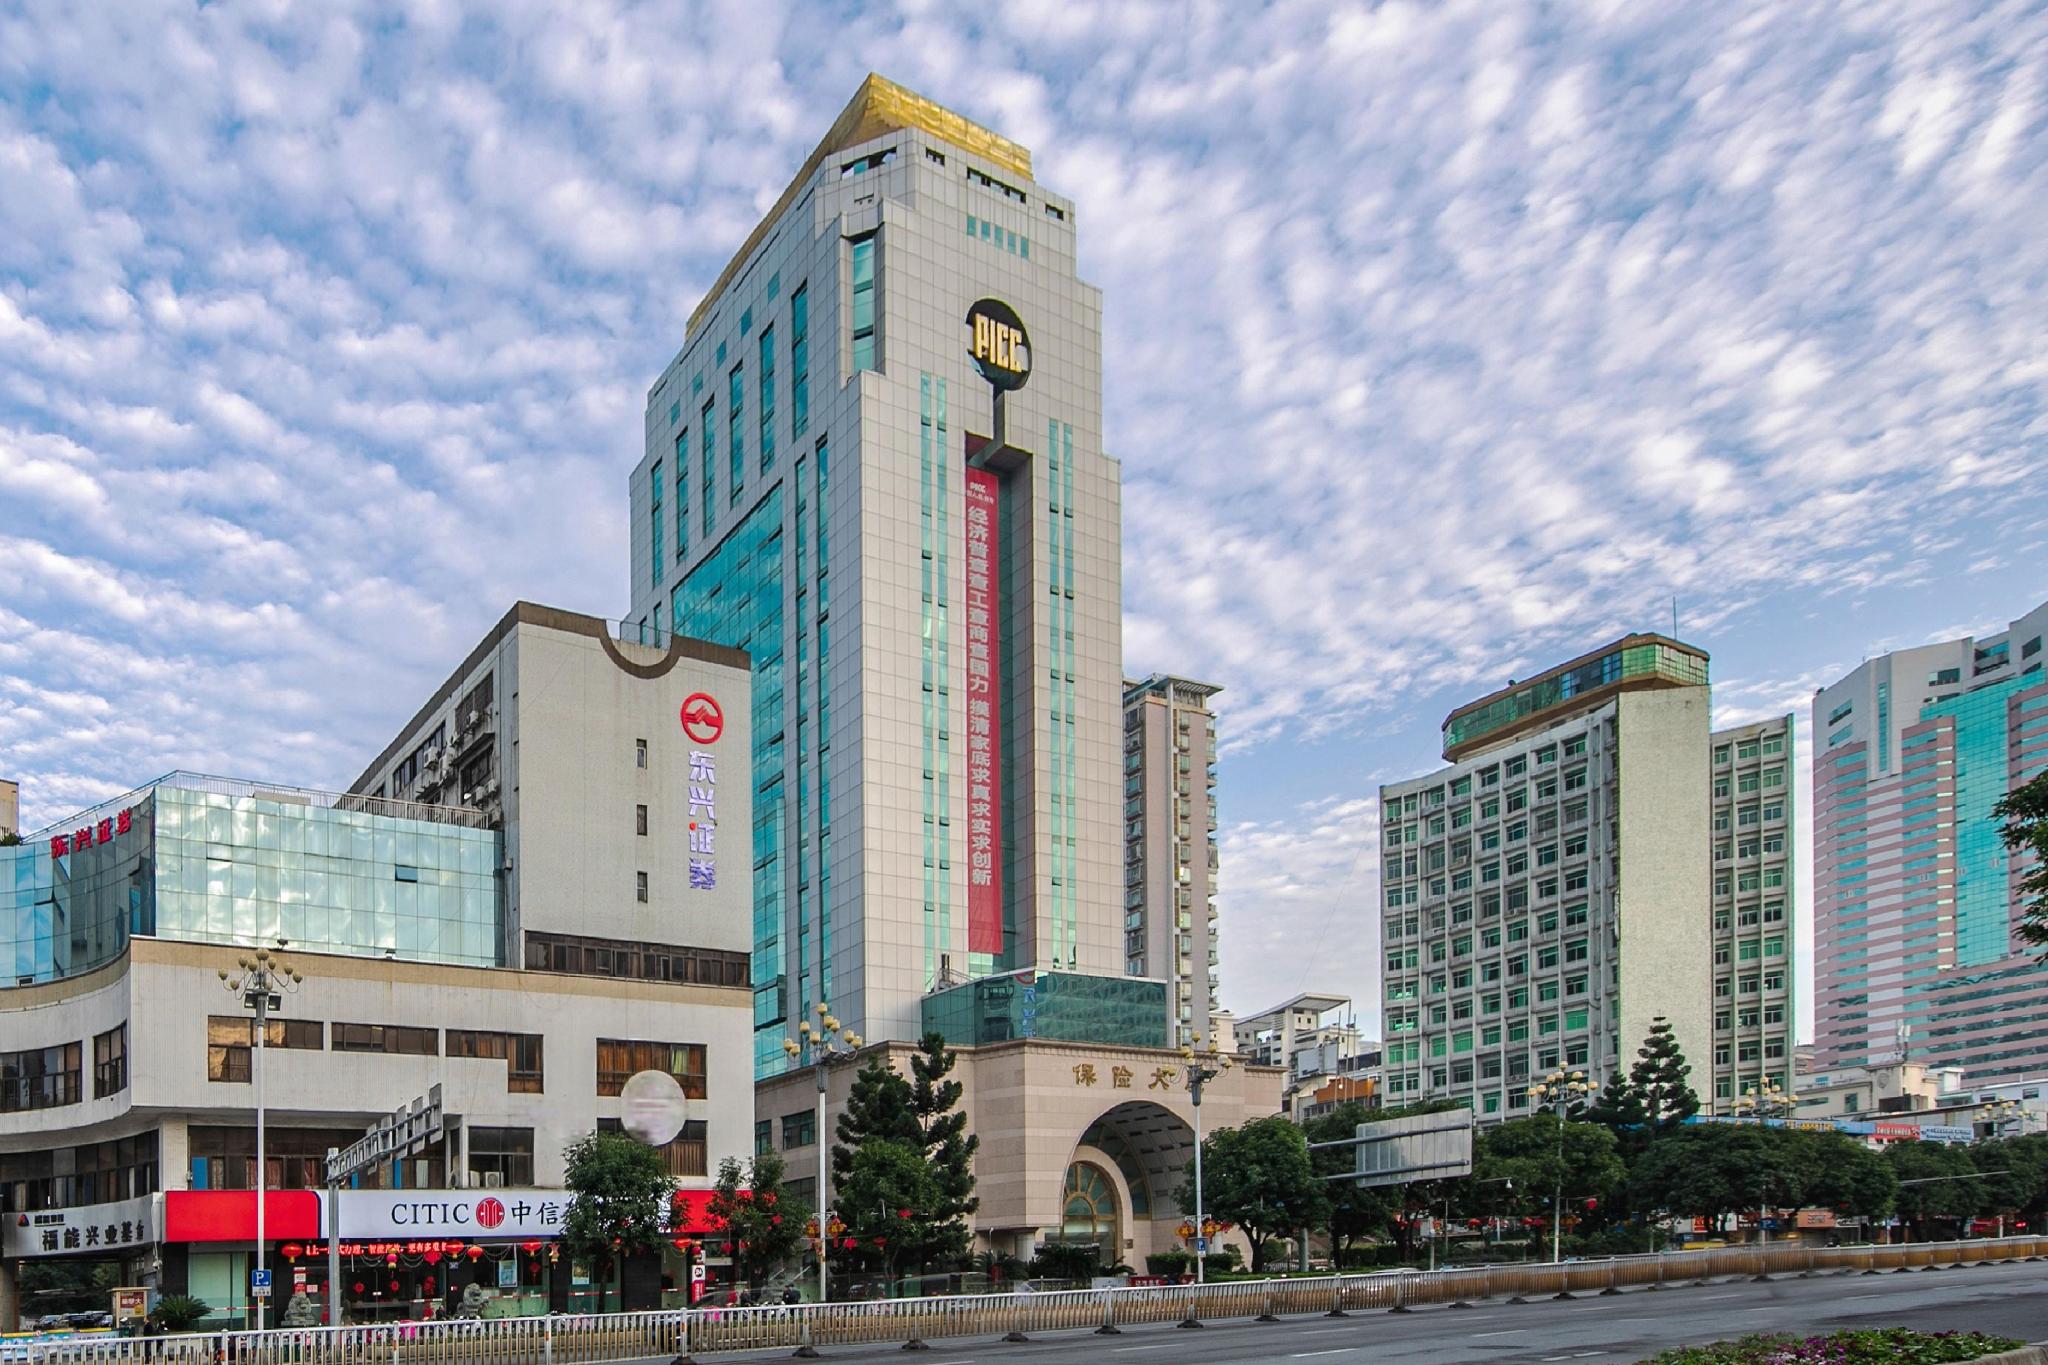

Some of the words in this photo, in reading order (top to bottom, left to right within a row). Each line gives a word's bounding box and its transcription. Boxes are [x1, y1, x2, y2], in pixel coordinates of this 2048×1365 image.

[975, 313, 1022, 373] PICC
[688, 750, 716, 890] 东兴证券
[1072, 1063, 1204, 1095] 保险大
[391, 1203, 469, 1225] CITIC
[255, 1271, 264, 1285] P
